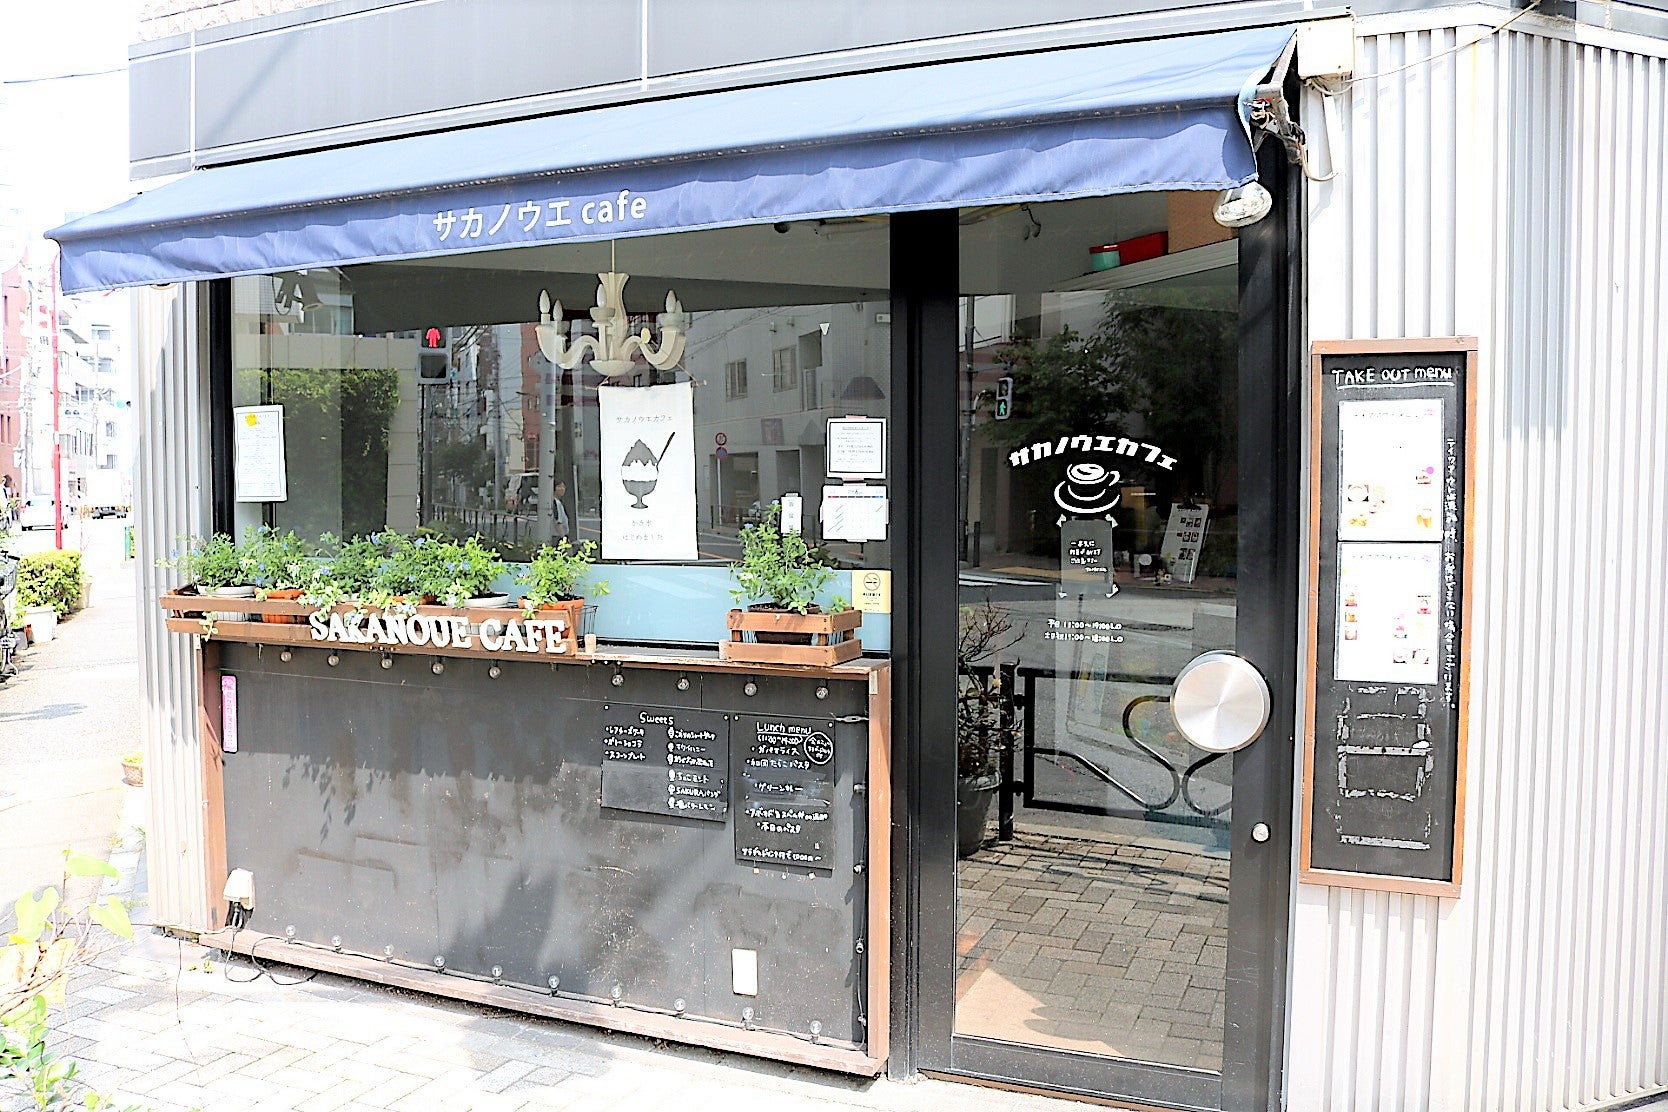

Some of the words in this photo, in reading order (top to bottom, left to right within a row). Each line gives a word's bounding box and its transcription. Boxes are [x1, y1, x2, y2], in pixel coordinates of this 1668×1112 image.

[432, 200, 572, 242] サカノウエ
[581, 189, 647, 225] cafe
[1331, 368, 1376, 385] TAKE
[1381, 368, 1411, 381] OUT
[1414, 366, 1453, 379] menu
[1008, 434, 1178, 471] サカノウエカフェ
[308, 610, 473, 648] SAKANOUE
[479, 617, 567, 654] CAFE
[639, 711, 674, 725] Sweets
[756, 721, 786, 733] Lunch
[788, 726, 812, 735] menu
